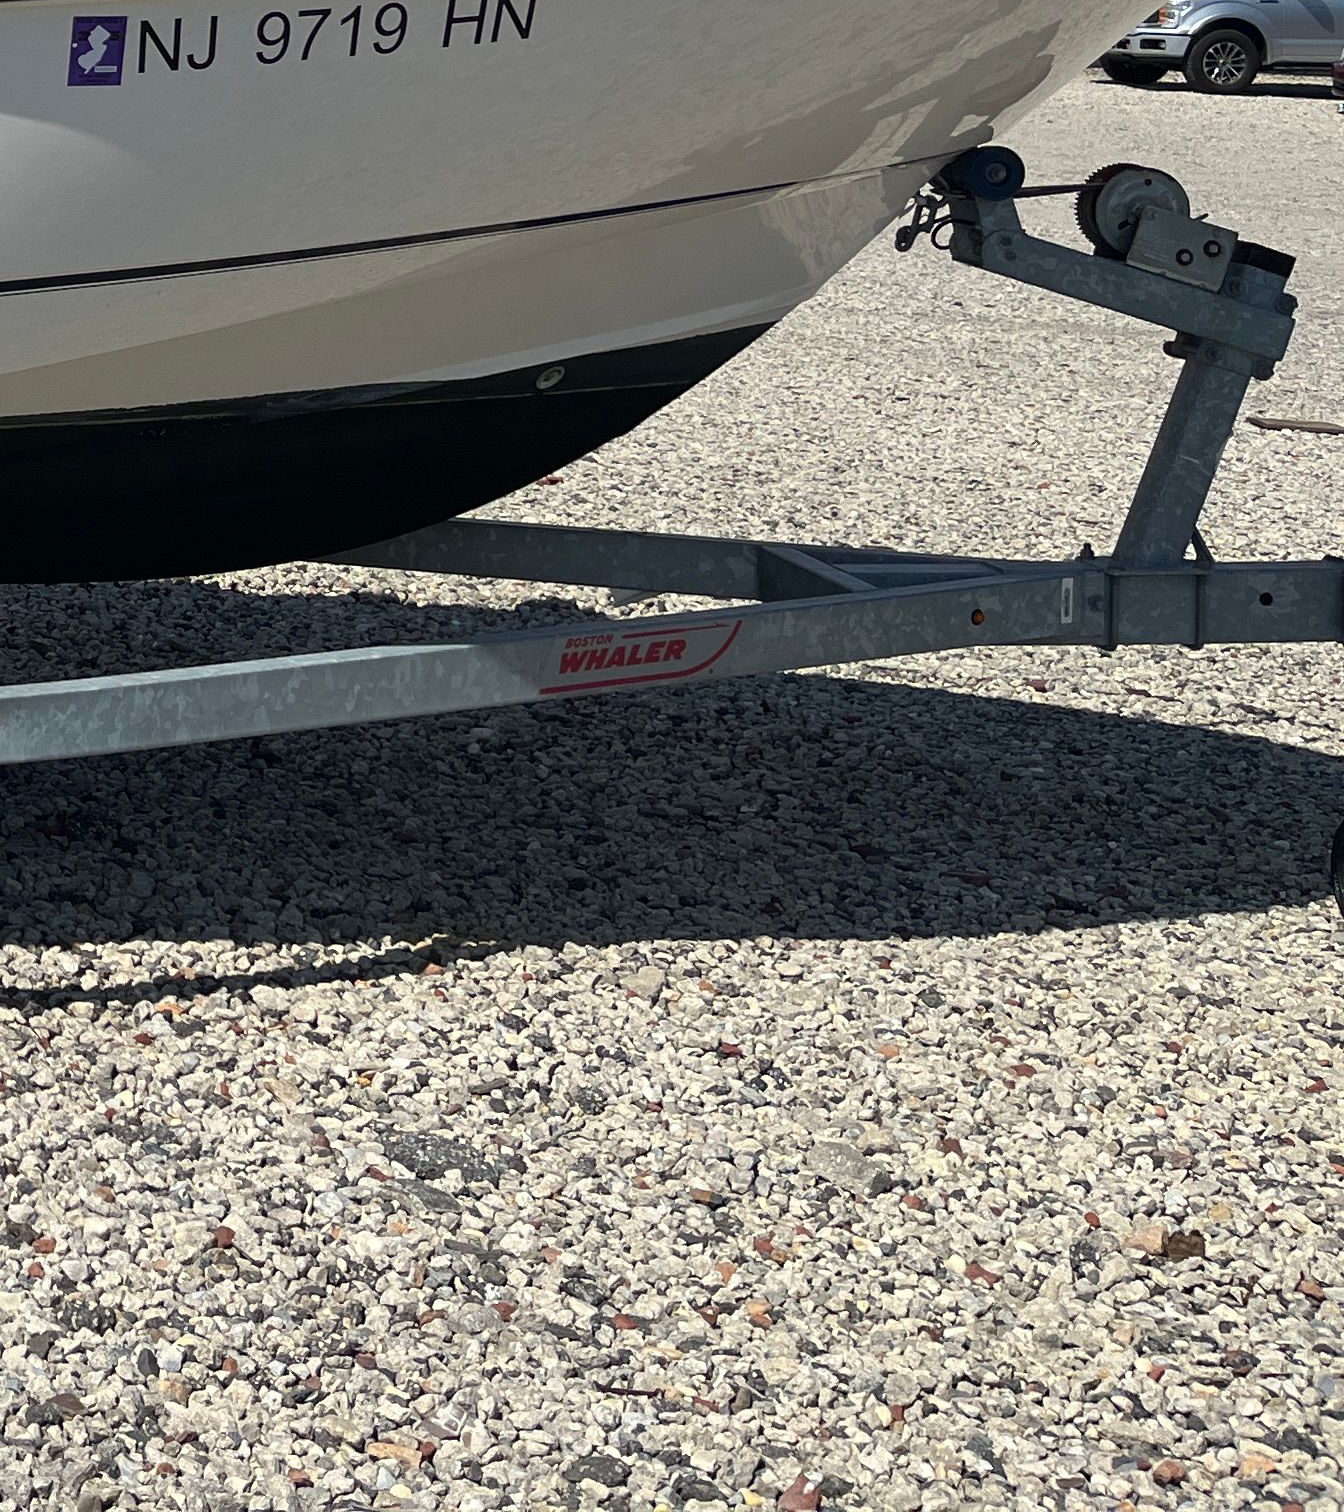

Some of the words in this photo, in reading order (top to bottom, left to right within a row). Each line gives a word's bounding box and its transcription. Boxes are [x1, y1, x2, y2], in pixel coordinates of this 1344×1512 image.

[137, 15, 219, 74] NJ
[255, 2, 409, 64] 9719
[559, 639, 687, 675] WHALER
[564, 634, 614, 649] BOSTON
